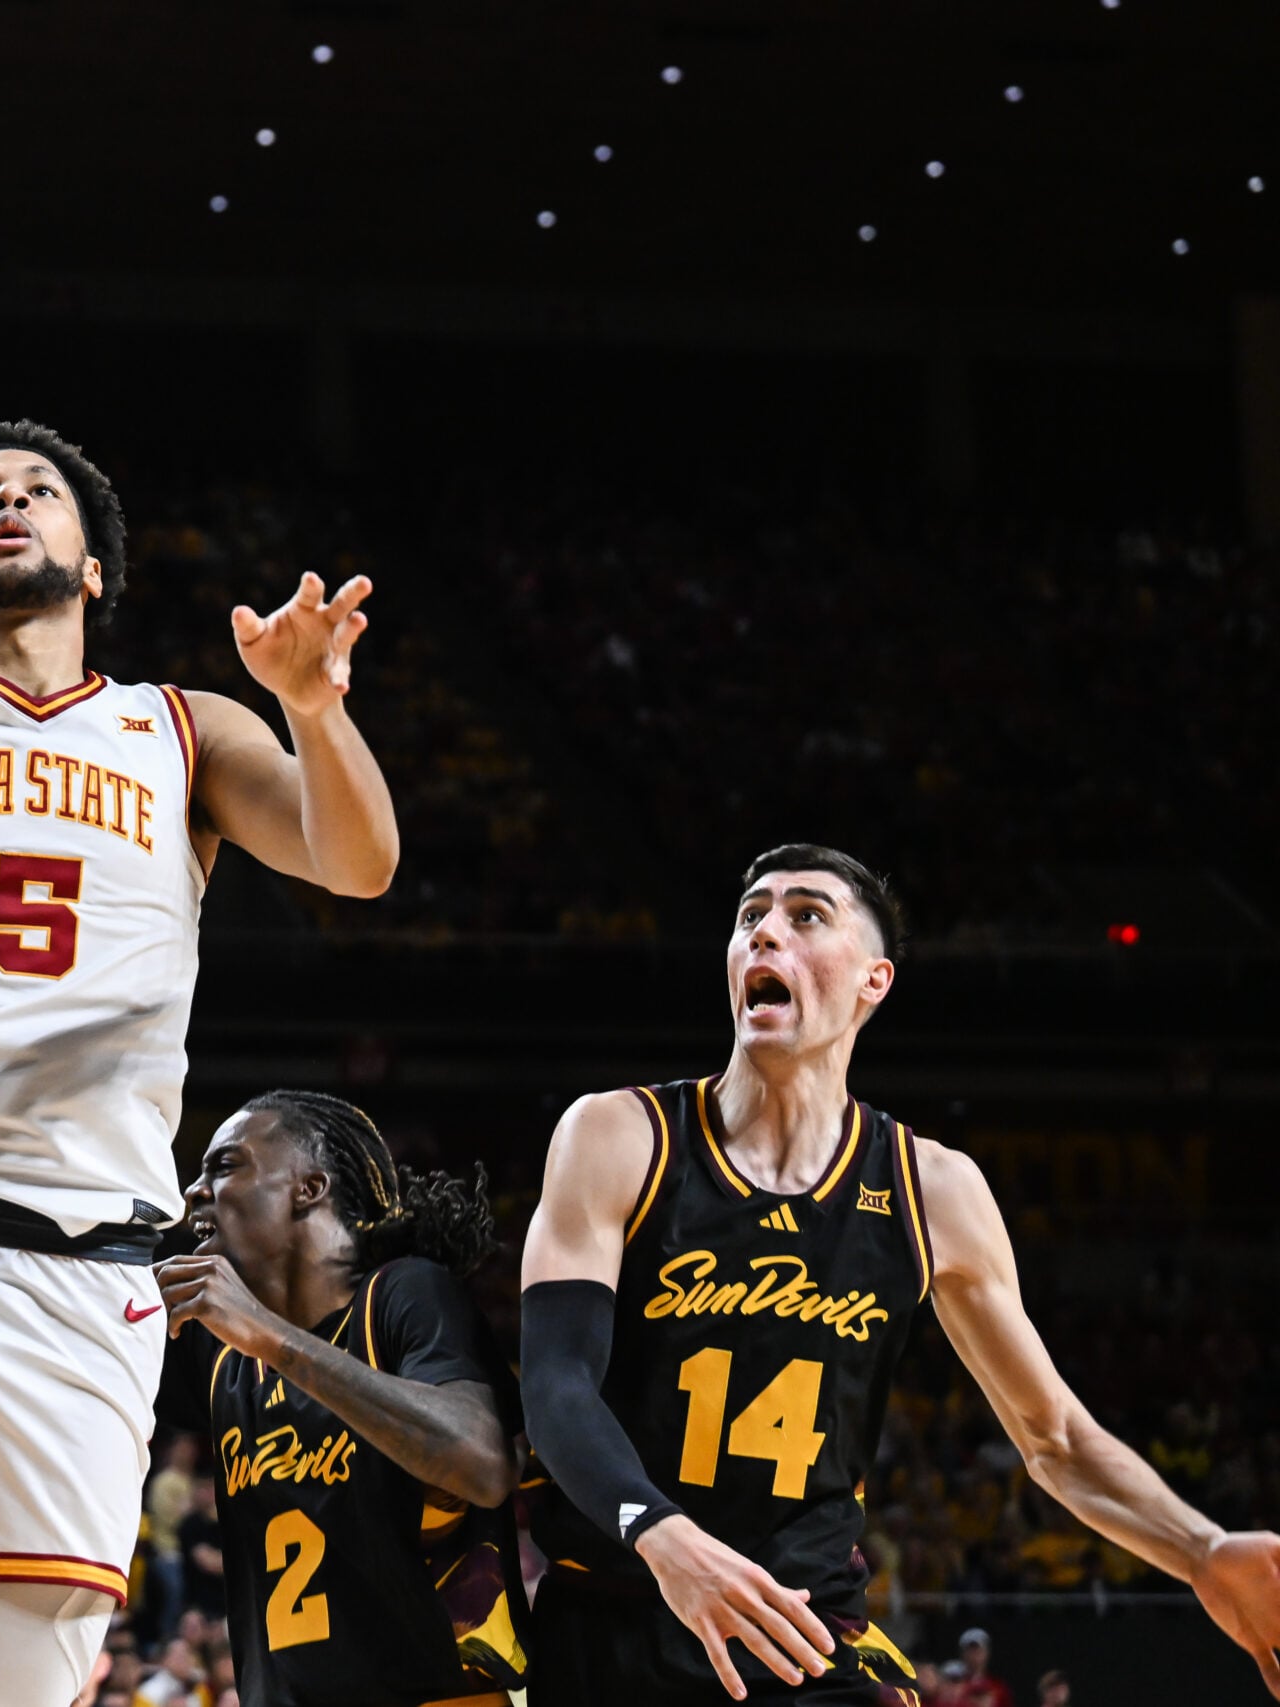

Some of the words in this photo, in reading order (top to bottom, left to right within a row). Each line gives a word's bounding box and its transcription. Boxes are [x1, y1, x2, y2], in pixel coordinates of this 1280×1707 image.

[24, 748, 155, 855] STATE
[677, 1347, 826, 1500] 14
[265, 1508, 330, 1651] 2
